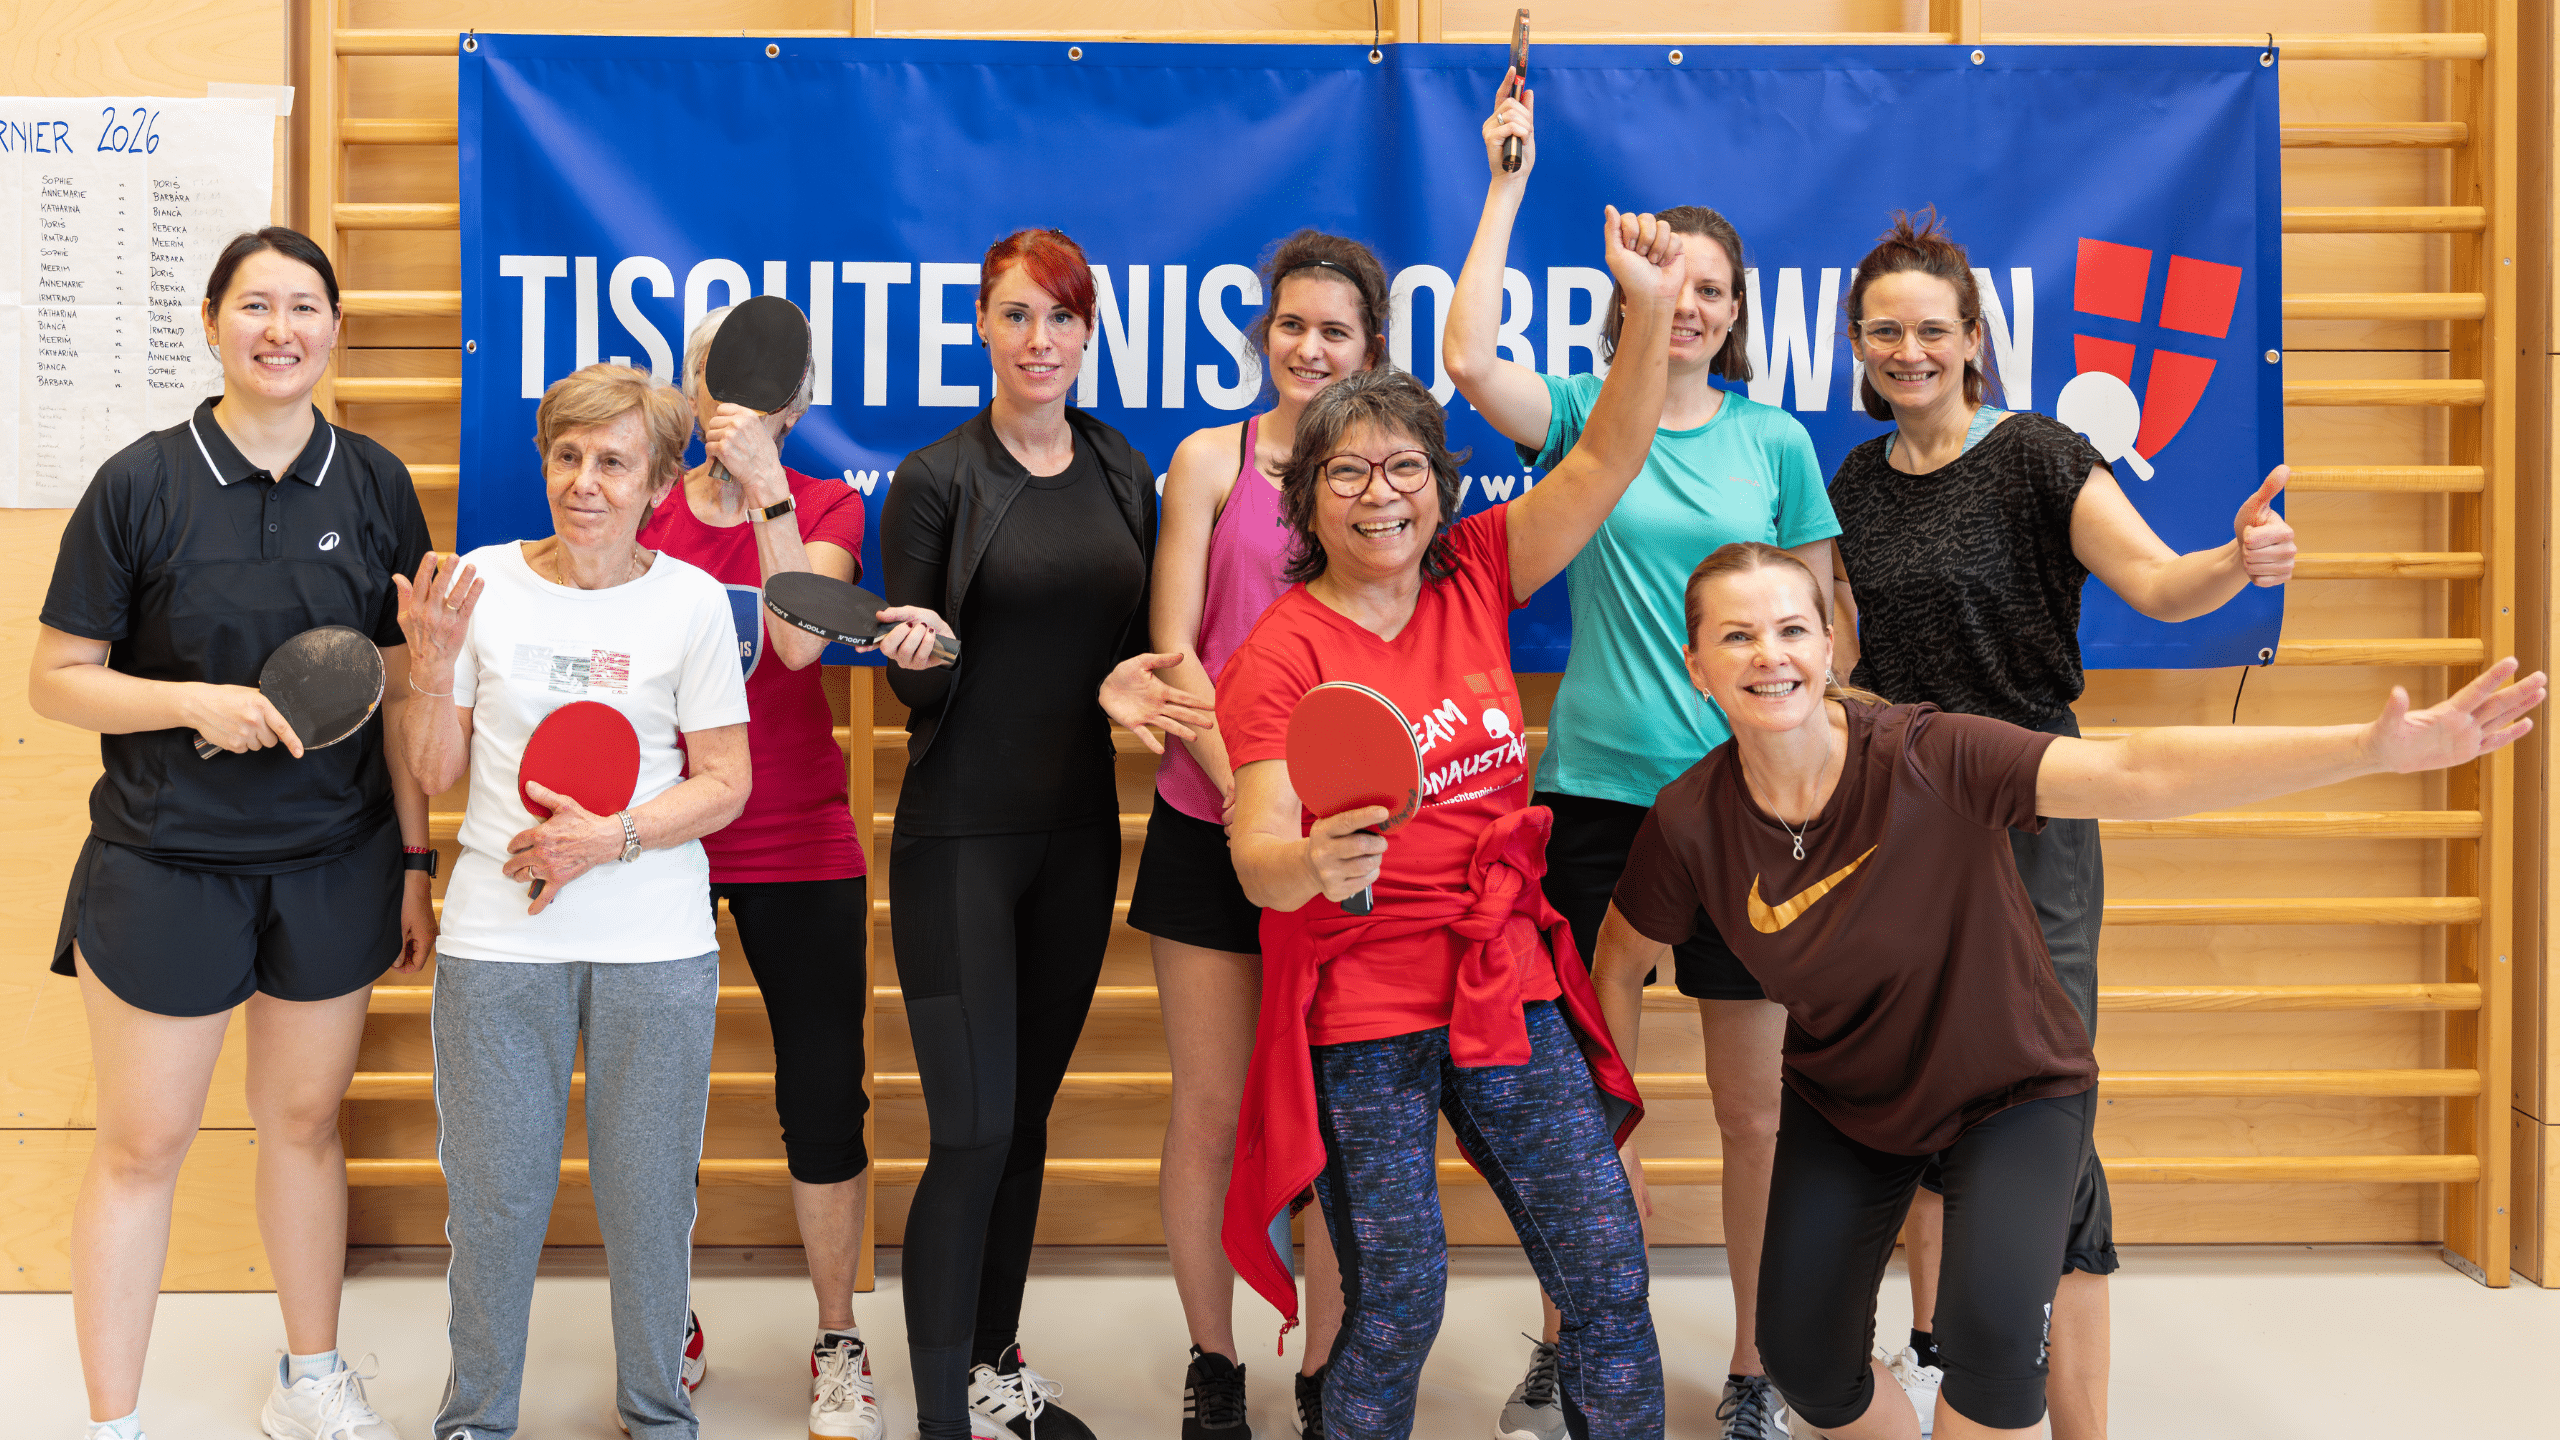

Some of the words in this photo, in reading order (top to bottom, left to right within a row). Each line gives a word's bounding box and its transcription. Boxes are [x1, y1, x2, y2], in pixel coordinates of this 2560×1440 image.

[97, 106, 160, 154] 2026
[42, 175, 73, 185] SOPHIE
[153, 180, 180, 189] DORIS
[42, 188, 87, 198] ANNEMARIE
[152, 191, 189, 202] BARBARA
[41, 203, 80, 213] KATHARINA
[153, 206, 182, 217] BIANCA
[40, 218, 66, 228] DORIS
[152, 222, 187, 233] REBEKKA
[42, 234, 78, 243] IRMTRAUD
[152, 237, 184, 248] MEERIM
[40, 248, 68, 256] SOPHIE
[150, 251, 184, 262] BARBARA
[41, 263, 70, 272] MEERIM
[150, 266, 174, 278] DORIS
[39, 278, 84, 288] ANNEMARIE
[151, 281, 185, 292] REBEKKA
[39, 294, 75, 303] IRMTRAUD
[148, 296, 182, 307] BARBARA
[38, 308, 77, 318] KATHARINA
[148, 311, 172, 323] DORIS
[37, 320, 66, 330] BIANCA
[150, 325, 184, 336] IRMTRAUD
[499, 255, 1263, 411] TISHTENIS
[1744, 267, 2035, 412] WN
[39, 334, 71, 344] MEERIM
[149, 338, 184, 348] REBEKKA
[39, 348, 78, 357] KATHARINA
[148, 351, 191, 362] ANNEMARIE
[37, 362, 66, 371] BIANCA
[148, 366, 176, 375] SOPHIE
[37, 375, 74, 386] BARBARA
[147, 379, 184, 388] REBEKKA
[838, 634, 862, 645] JOOLA
[1413, 698, 1468, 757] EAM
